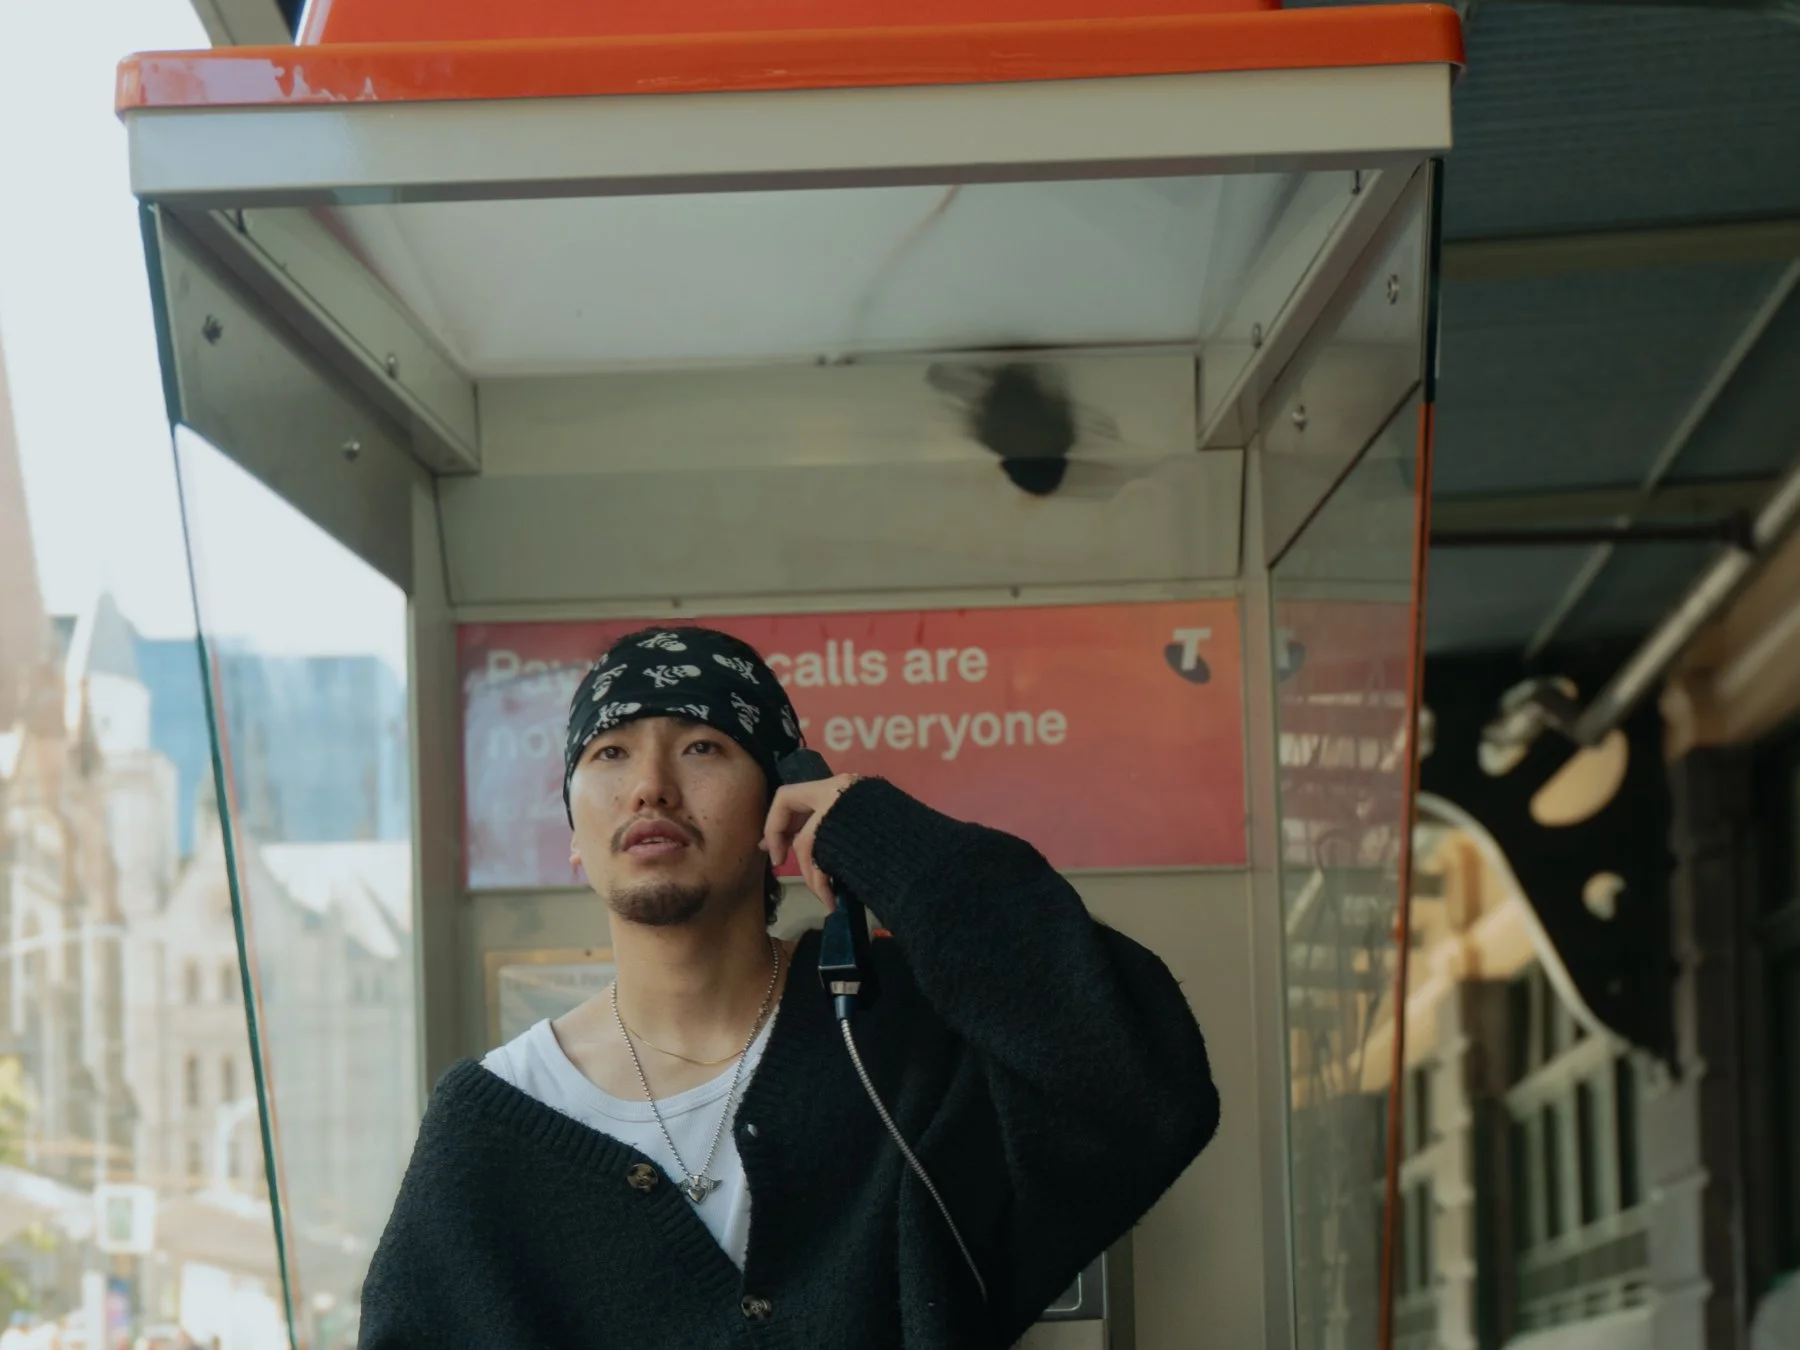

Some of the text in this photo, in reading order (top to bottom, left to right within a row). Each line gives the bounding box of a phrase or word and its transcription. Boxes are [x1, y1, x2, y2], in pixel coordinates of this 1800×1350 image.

[767, 640, 887, 686] calls
[902, 647, 987, 683] are
[1172, 628, 1212, 670] T
[487, 724, 565, 761] no
[823, 710, 1068, 761] everyone
